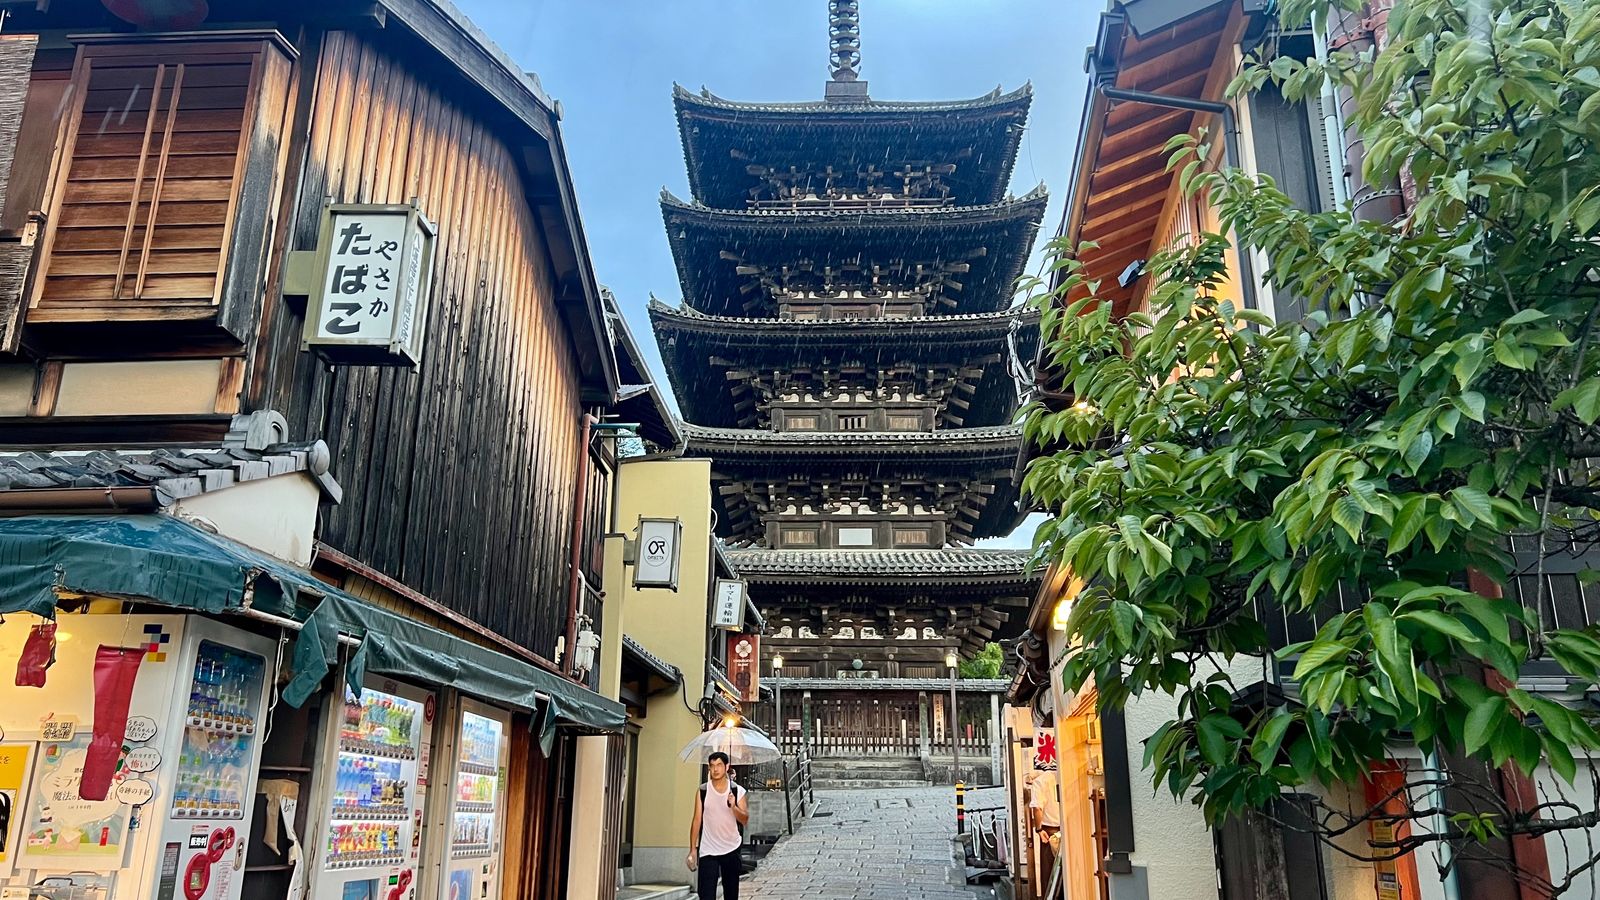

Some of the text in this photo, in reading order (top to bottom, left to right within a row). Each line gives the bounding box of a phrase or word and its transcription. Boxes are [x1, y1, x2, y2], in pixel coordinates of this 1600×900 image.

[325, 222, 372, 335] たばこ
[369, 240, 398, 318] やさか
